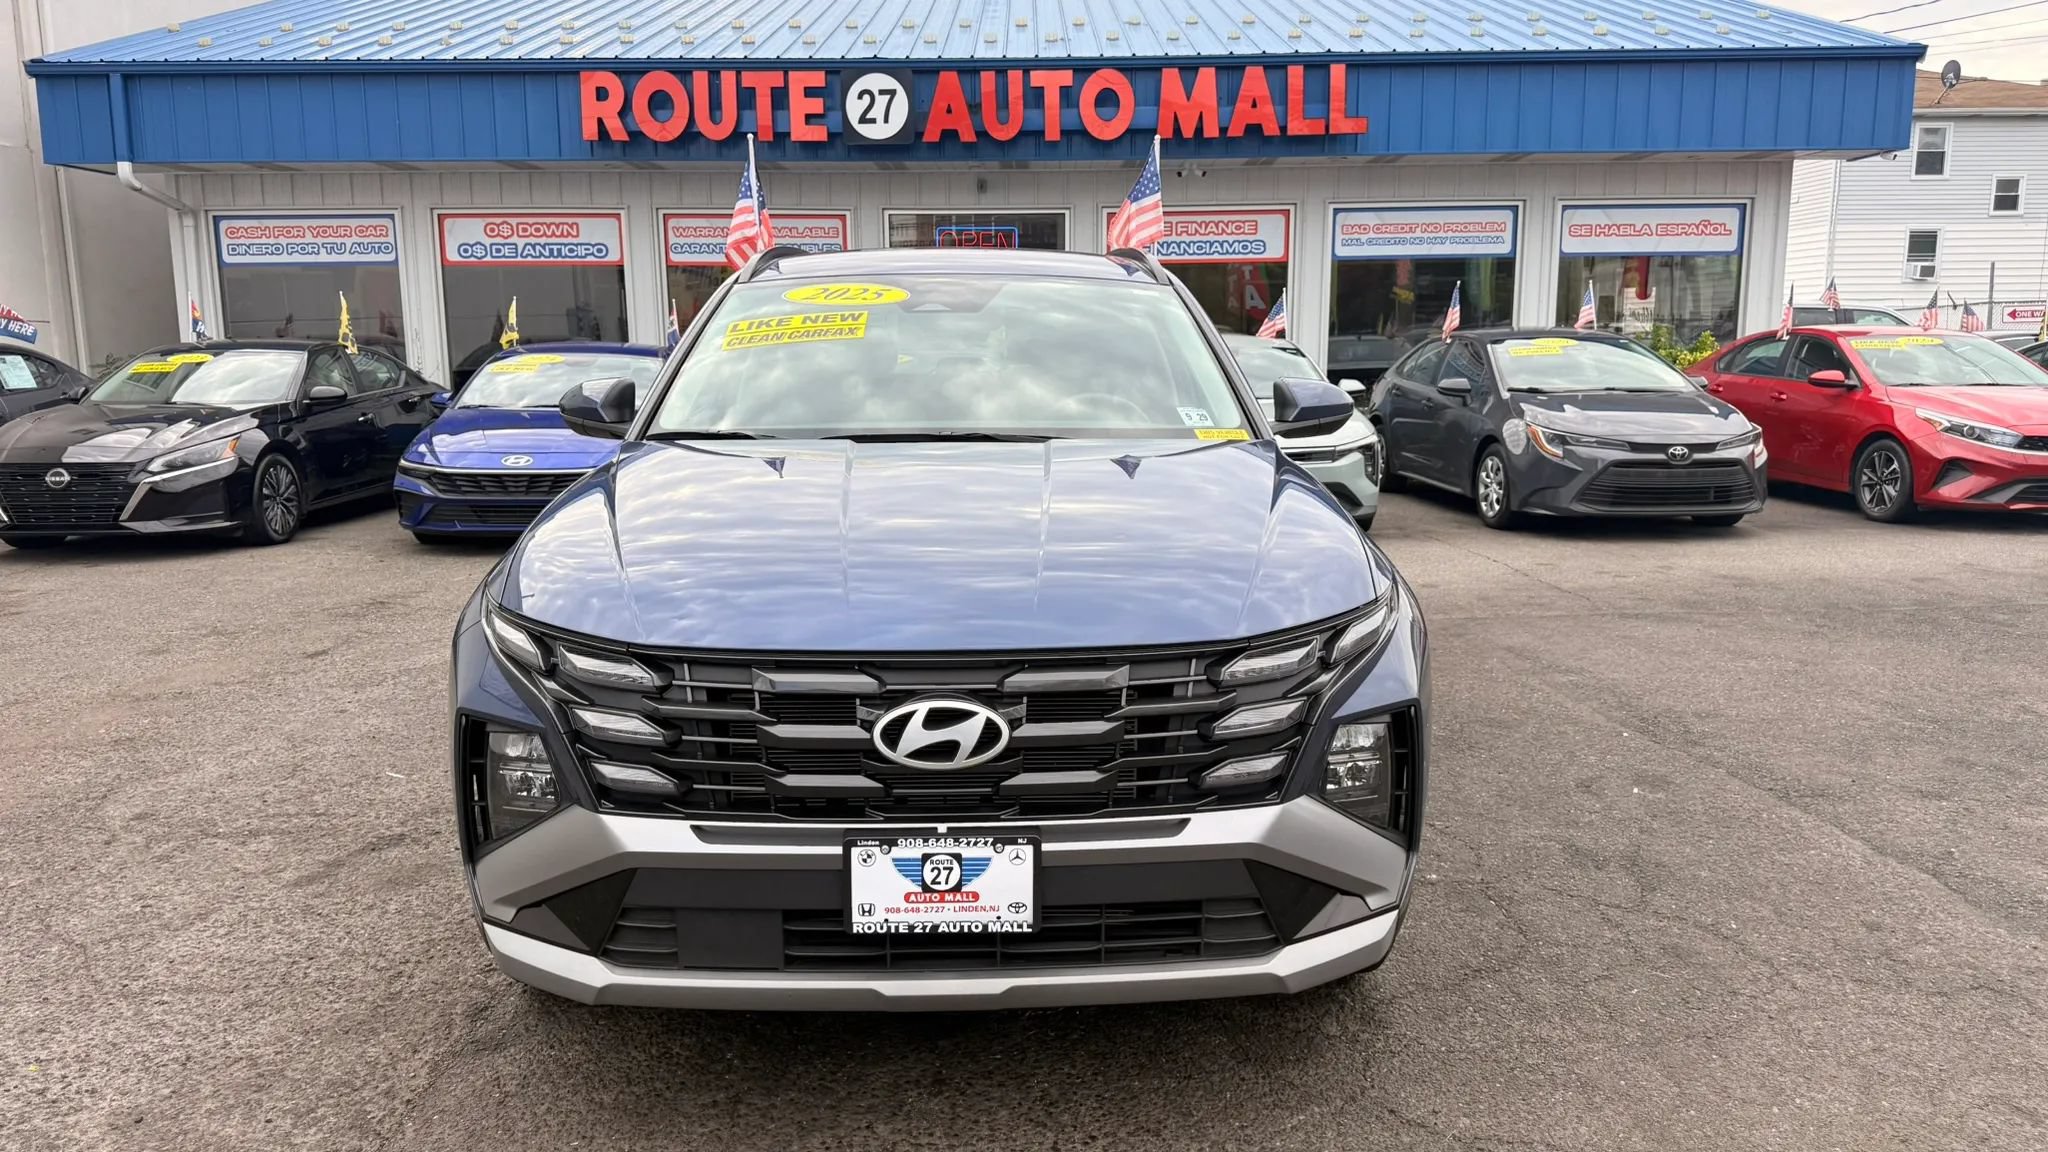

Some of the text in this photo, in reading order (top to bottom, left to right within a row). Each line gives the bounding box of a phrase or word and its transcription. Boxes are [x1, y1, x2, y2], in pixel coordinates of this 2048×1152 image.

[579, 64, 1368, 142] ROUTE 27 AUTO MALL
[225, 225, 389, 238] CASH FOR YOUR CAR
[516, 221, 579, 238] DOWN
[1175, 220, 1258, 236] FINANCE
[1341, 221, 1506, 235] BAD CREDIT NO PROBLEM
[1568, 219, 1732, 237] SE HABLA ESPAÑOL
[1341, 235, 1505, 247] MAL CREDITO NO HAY PROBLEMA
[227, 242, 394, 256] DINERO POR TU AUTO
[490, 243, 517, 258] DE
[520, 243, 608, 259] ANTICIPO
[671, 243, 727, 255] GARANT
[802, 287, 893, 301] 2025
[8, 319, 36, 336] HERE
[730, 312, 865, 333] LIKE NEW
[725, 326, 860, 347] CLEAN CARFAX
[897, 838, 994, 849] 908-648-2727
[929, 858, 954, 866] ROUTE
[930, 866, 955, 886] 27
[908, 892, 976, 902] AUTO MALL
[884, 906, 946, 914] 908-648-2727
[853, 921, 1033, 934] ROUTE 27 AUTO MALL
